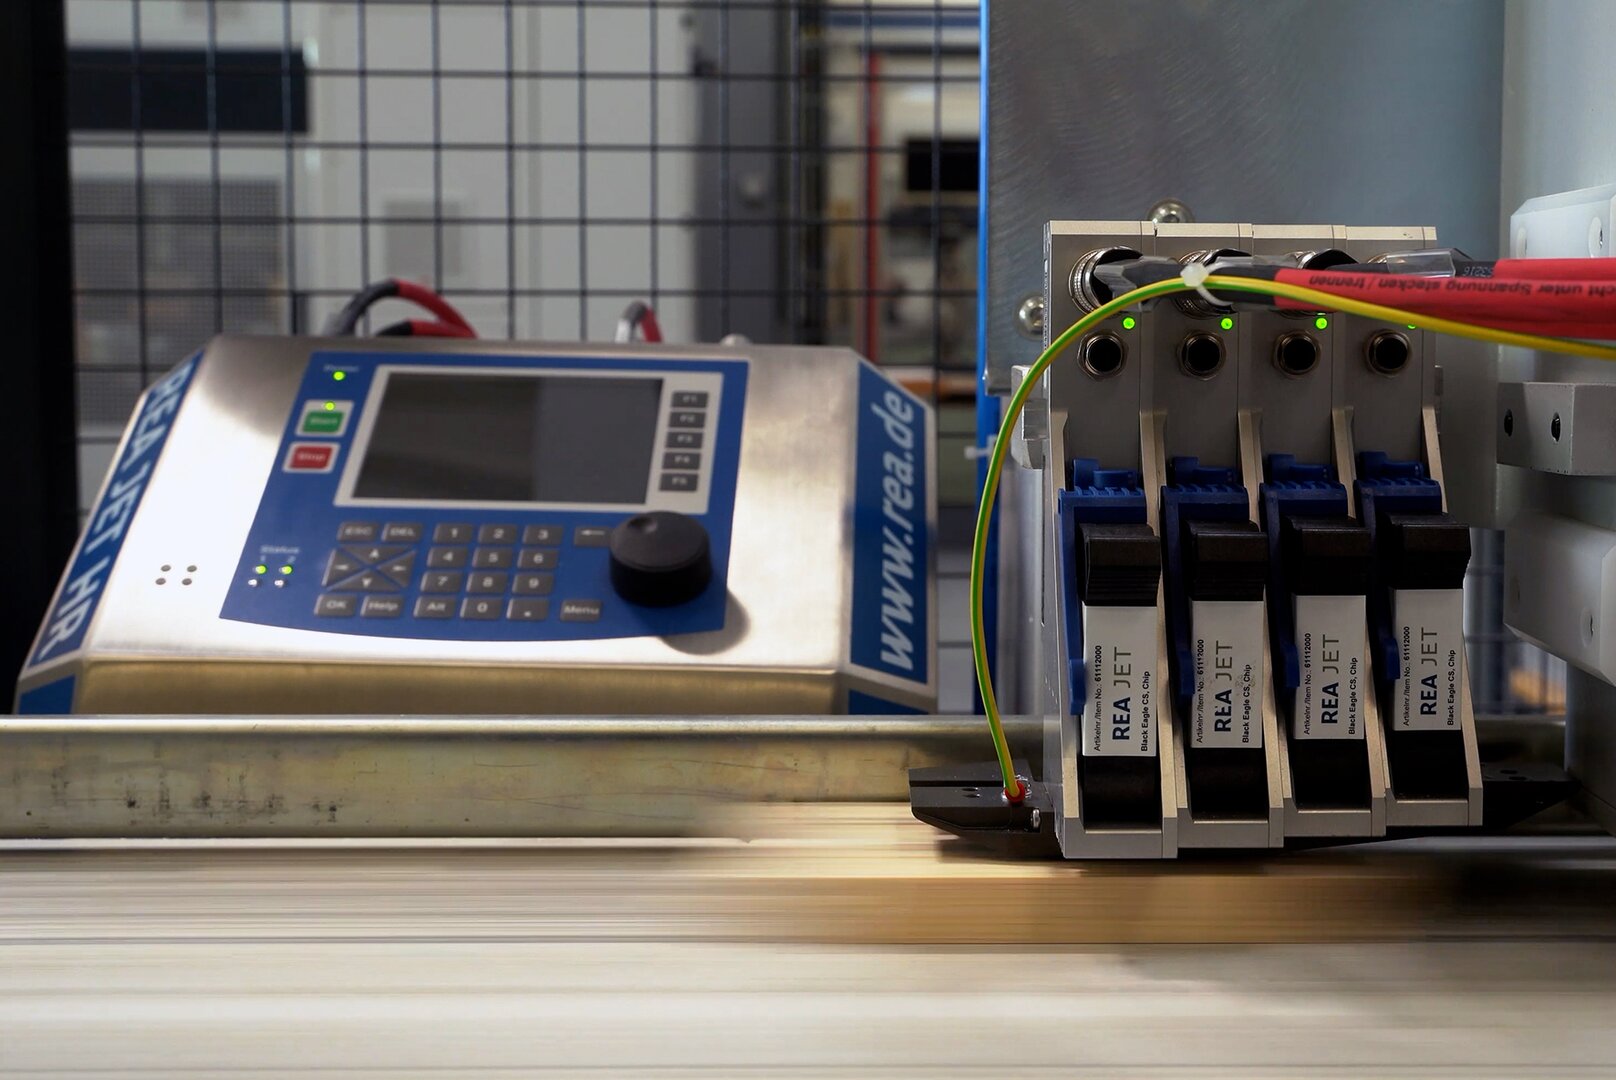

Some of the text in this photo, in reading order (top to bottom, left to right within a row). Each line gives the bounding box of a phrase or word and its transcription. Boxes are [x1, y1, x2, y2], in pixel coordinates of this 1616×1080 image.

[1309, 275, 1366, 289] trennen
[1378, 278, 1441, 291] stecken
[1446, 278, 1532, 295] Spannung
[1538, 282, 1583, 296] unter
[38, 361, 195, 661] REA JET HR
[870, 390, 914, 671] www.rea.de
[1094, 645, 1102, 682] 61112000
[1420, 626, 1437, 715] REA JET
[1448, 649, 1457, 667] Chip
[1214, 640, 1233, 732] REA JET
[1243, 664, 1252, 682] Chip
[1321, 634, 1339, 724] REA JET
[1112, 646, 1131, 740] REA JET
[1243, 684, 1251, 697] CS,
[1348, 657, 1358, 735] Black Eagle CS, Chip
[1447, 683, 1456, 704] Eagle
[1140, 671, 1151, 752] Black Eagle CS, Chip
[1243, 699, 1251, 720] Eagle
